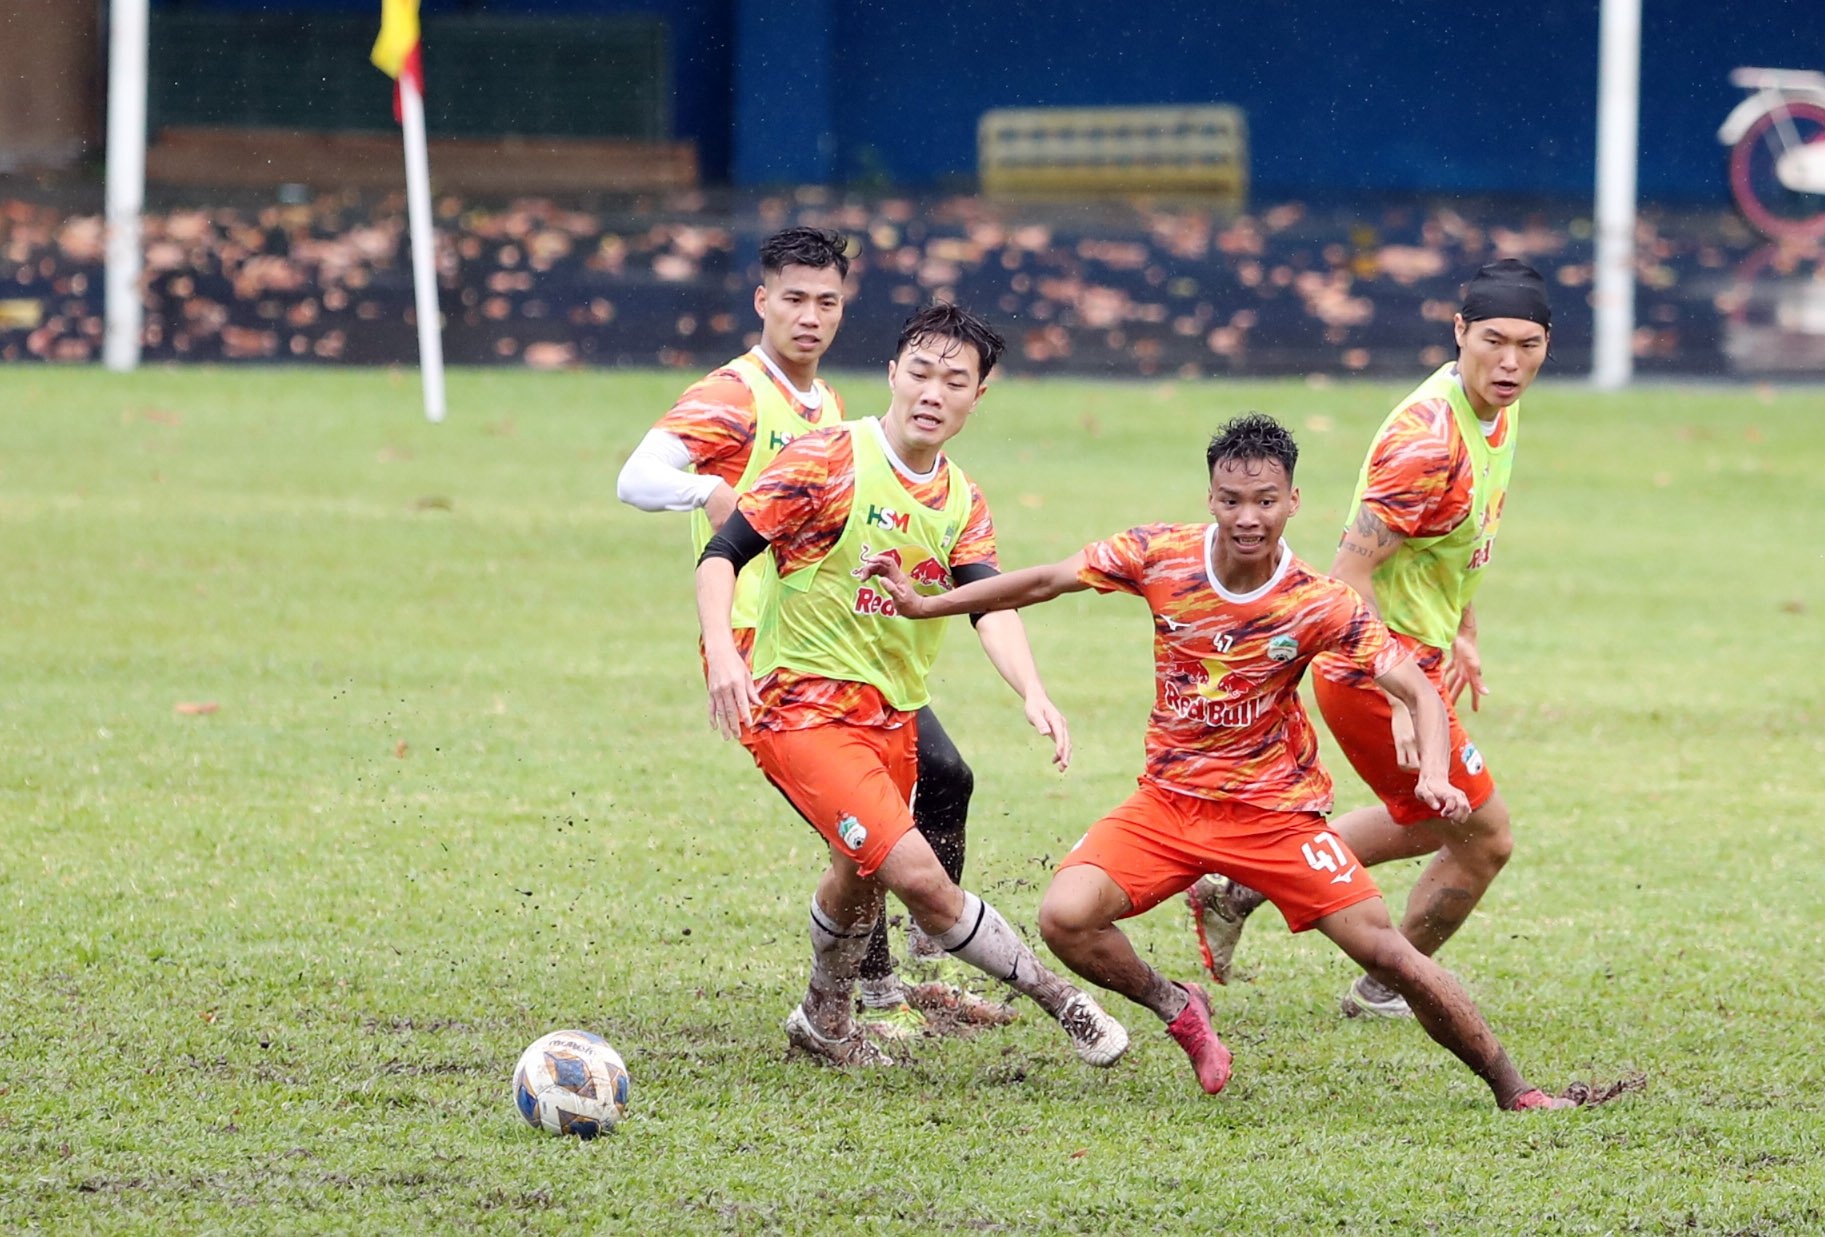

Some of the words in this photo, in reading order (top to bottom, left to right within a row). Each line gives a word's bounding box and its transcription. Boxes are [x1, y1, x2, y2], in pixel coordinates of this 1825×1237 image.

[769, 430, 796, 450] HS
[866, 504, 910, 534] HSM
[1213, 633, 1234, 653] 47
[1165, 681, 1206, 721] Red
[1206, 698, 1260, 727] Bull
[1301, 831, 1348, 873] 47
